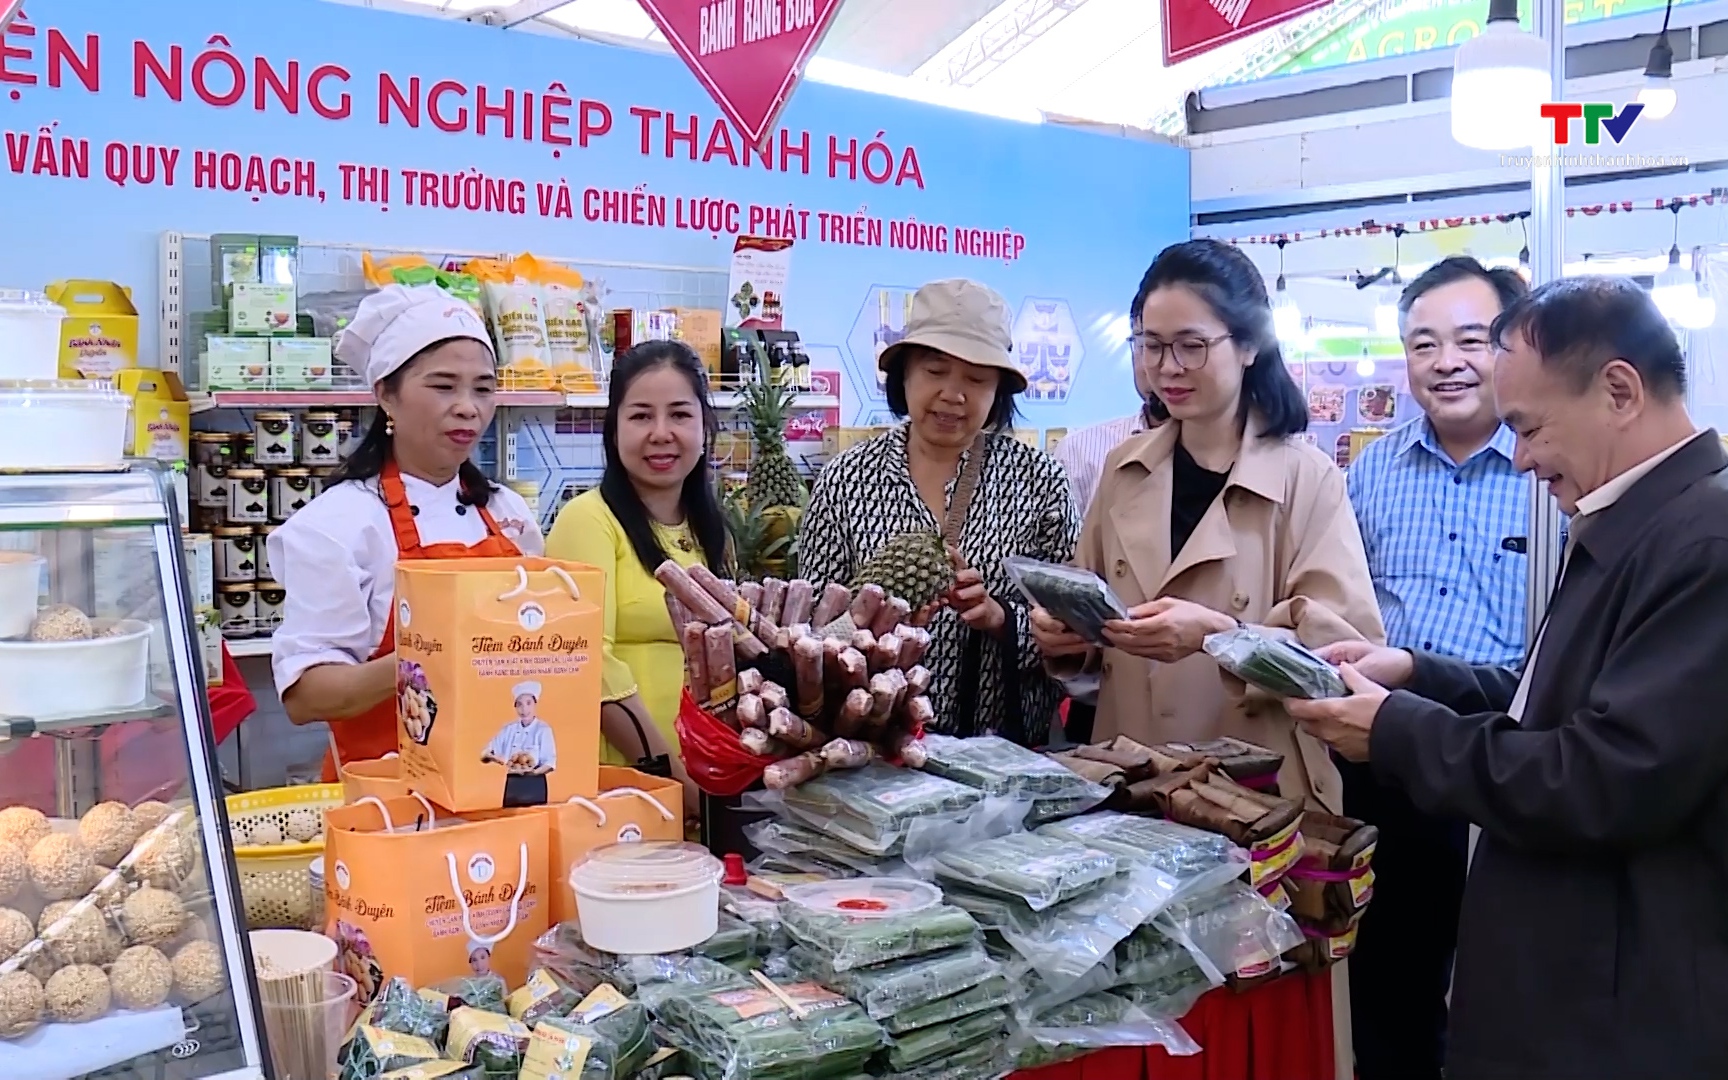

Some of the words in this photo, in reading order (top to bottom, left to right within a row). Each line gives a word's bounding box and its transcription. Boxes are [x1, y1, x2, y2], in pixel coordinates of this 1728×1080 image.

[133, 34, 351, 120] NÔNG
[379, 72, 613, 158] NGHIỆP
[629, 106, 811, 175] THANH
[828, 130, 925, 190] HÓA
[5, 121, 89, 178] VẤN
[105, 142, 180, 187] QUY
[194, 151, 326, 204] HOẠCH,
[338, 163, 390, 212] THỊ
[401, 166, 525, 214] TRƯỜNG
[536, 178, 574, 220] VÀ
[583, 184, 667, 227] CHIẾN
[675, 197, 740, 240] LƯỢC
[748, 202, 811, 240] PHÁT
[818, 205, 883, 248] TRIỂN
[889, 216, 948, 254] NÔNG
[954, 227, 1025, 266] NGHIỆP
[507, 634, 545, 653] Bánh
